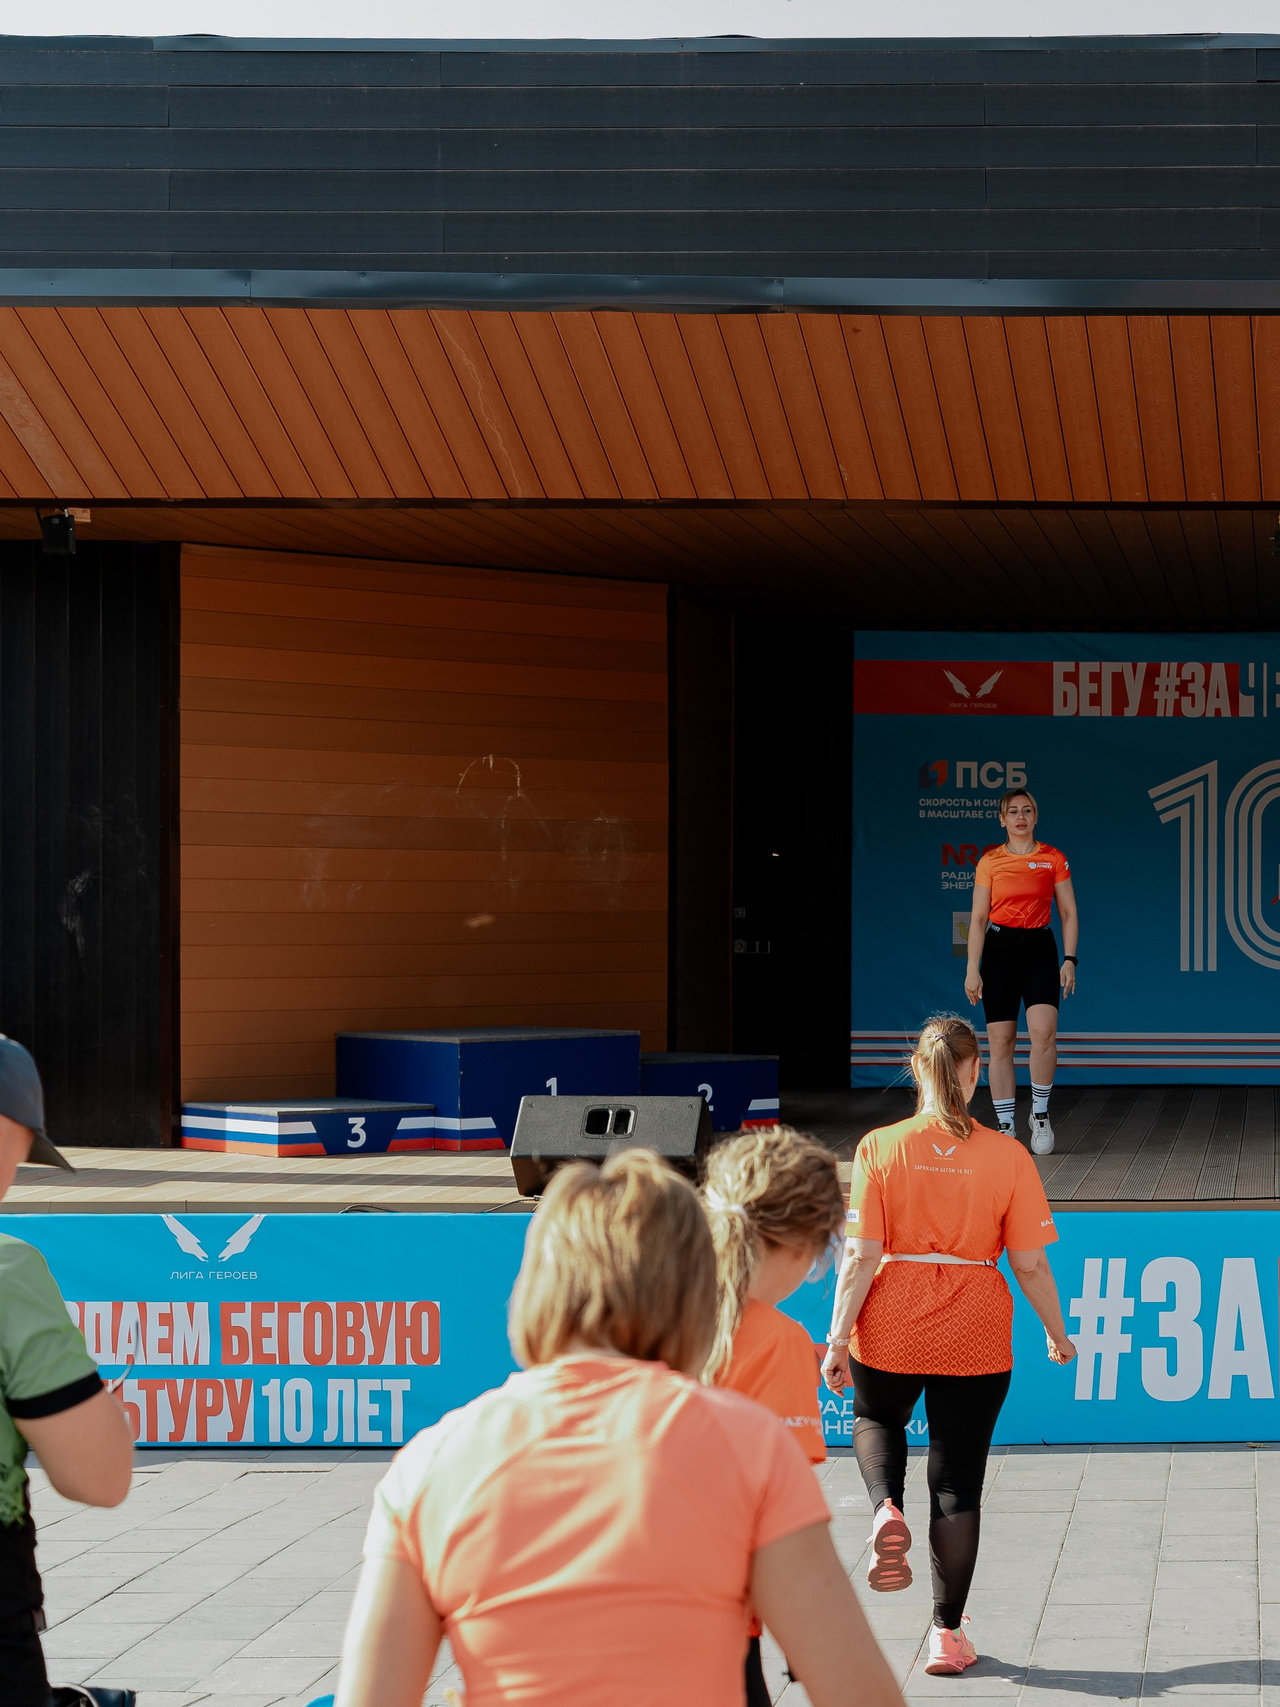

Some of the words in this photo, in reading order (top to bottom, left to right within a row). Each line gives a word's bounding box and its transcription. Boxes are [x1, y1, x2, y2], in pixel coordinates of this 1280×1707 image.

[1053, 661, 1148, 717] БЕГУ
[956, 761, 1028, 788] ПСБ
[919, 798, 972, 807] СКОРОСТЬ
[974, 799, 981, 807] И
[919, 810, 926, 818] В
[928, 810, 984, 818] МАСШТАБЕ
[346, 1117, 367, 1149] 3
[170, 1271, 204, 1280] ЛИГА
[208, 1270, 258, 1280] ГЕРОЕВ
[220, 1301, 440, 1366] БЕГОВУЮ
[262, 1378, 313, 1443] 10
[323, 1378, 411, 1443] ЛЕТ
